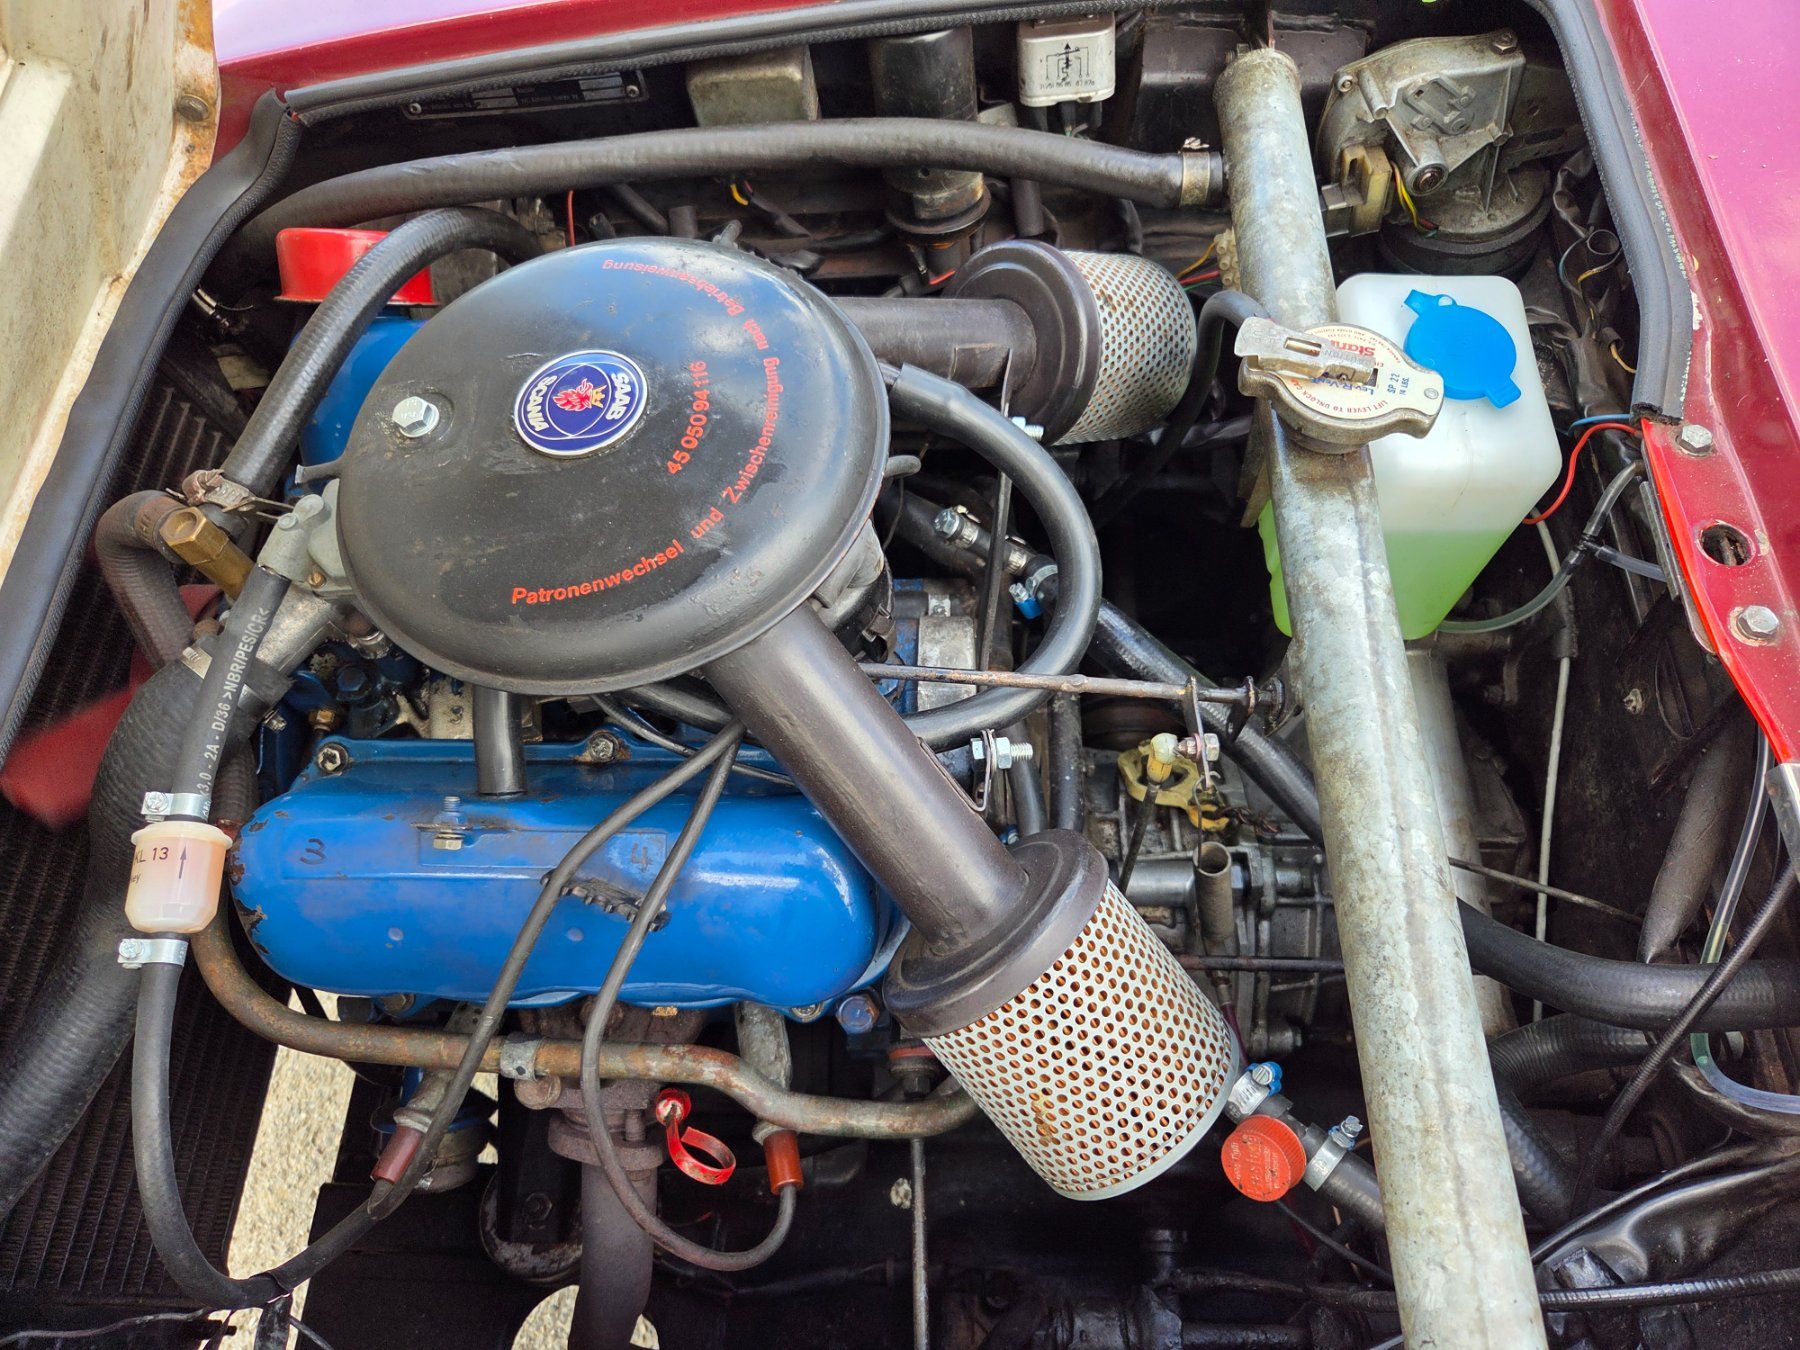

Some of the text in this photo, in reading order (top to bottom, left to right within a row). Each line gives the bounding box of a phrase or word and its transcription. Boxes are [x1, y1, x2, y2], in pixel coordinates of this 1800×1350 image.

[605, 373, 632, 420] SAAB
[1387, 373, 1400, 394] SP 22
[527, 375, 558, 432] SCANIA
[1302, 390, 1331, 409] UNLOCK
[1373, 400, 1389, 410] LIFT
[511, 259, 784, 604] Patronenwechsel und Zwischenreinigung nach Betriebsanweisung
[666, 361, 710, 475] 45 050 94 116
[223, 607, 270, 700] >NBR/PES/CR<
[211, 702, 231, 733] D/36
[204, 741, 220, 763] 2A
[152, 846, 169, 861] 13
